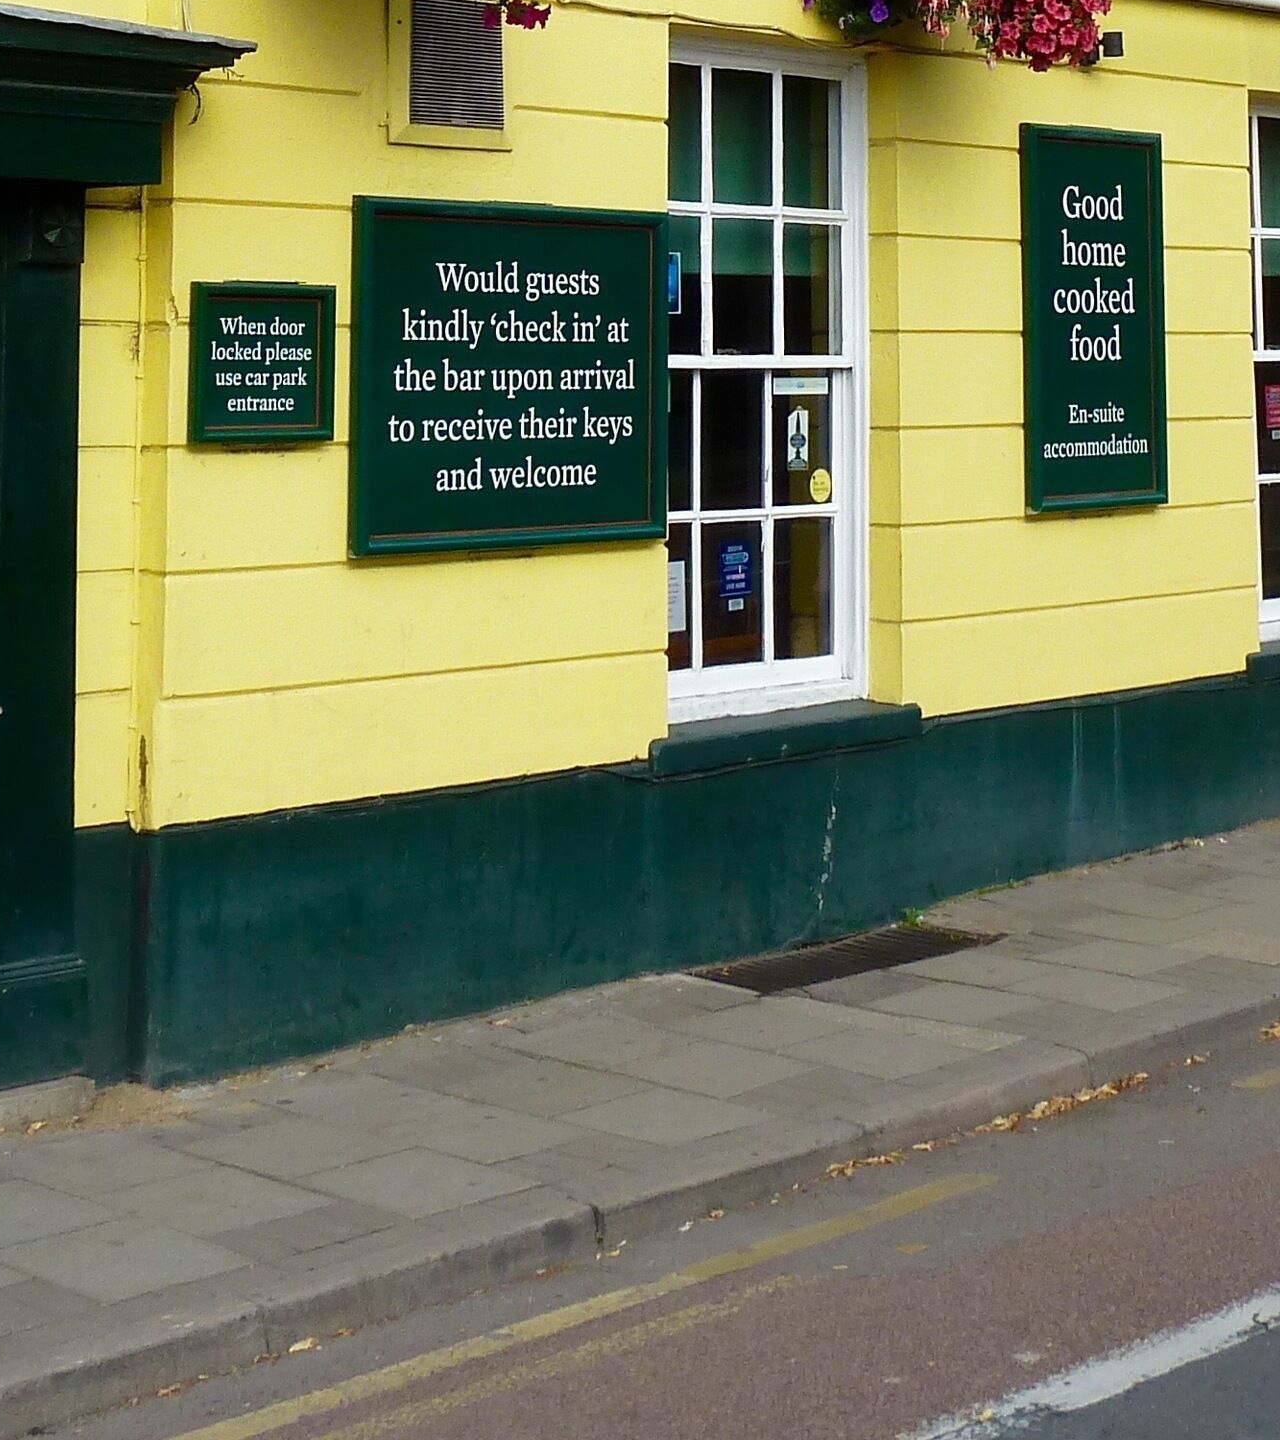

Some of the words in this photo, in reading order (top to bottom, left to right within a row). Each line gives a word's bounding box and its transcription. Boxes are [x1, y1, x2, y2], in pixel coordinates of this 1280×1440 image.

[1061, 185, 1124, 221] Good
[1061, 229, 1126, 267] home
[435, 261, 519, 294] Would
[525, 269, 600, 301] guests
[1053, 277, 1135, 314] cooked
[219, 317, 267, 337] When
[270, 317, 305, 337] door
[401, 309, 484, 350] kindly
[607, 318, 629, 343] at
[1069, 324, 1122, 361] food
[211, 342, 262, 362] locked
[265, 343, 312, 365] please
[215, 371, 242, 387] use
[245, 372, 269, 387] car
[272, 367, 307, 390] park
[393, 360, 435, 391] the
[443, 358, 486, 391] bar
[491, 366, 554, 399] upon
[560, 360, 635, 391] arrival
[227, 395, 294, 413] entrance
[1068, 403, 1125, 424] En-suite
[388, 417, 415, 442] to
[420, 409, 513, 441] receive
[518, 408, 577, 440] their
[582, 407, 633, 445] keys
[1043, 433, 1149, 459] accommodation
[435, 458, 483, 492] and
[489, 456, 597, 489] welcome
